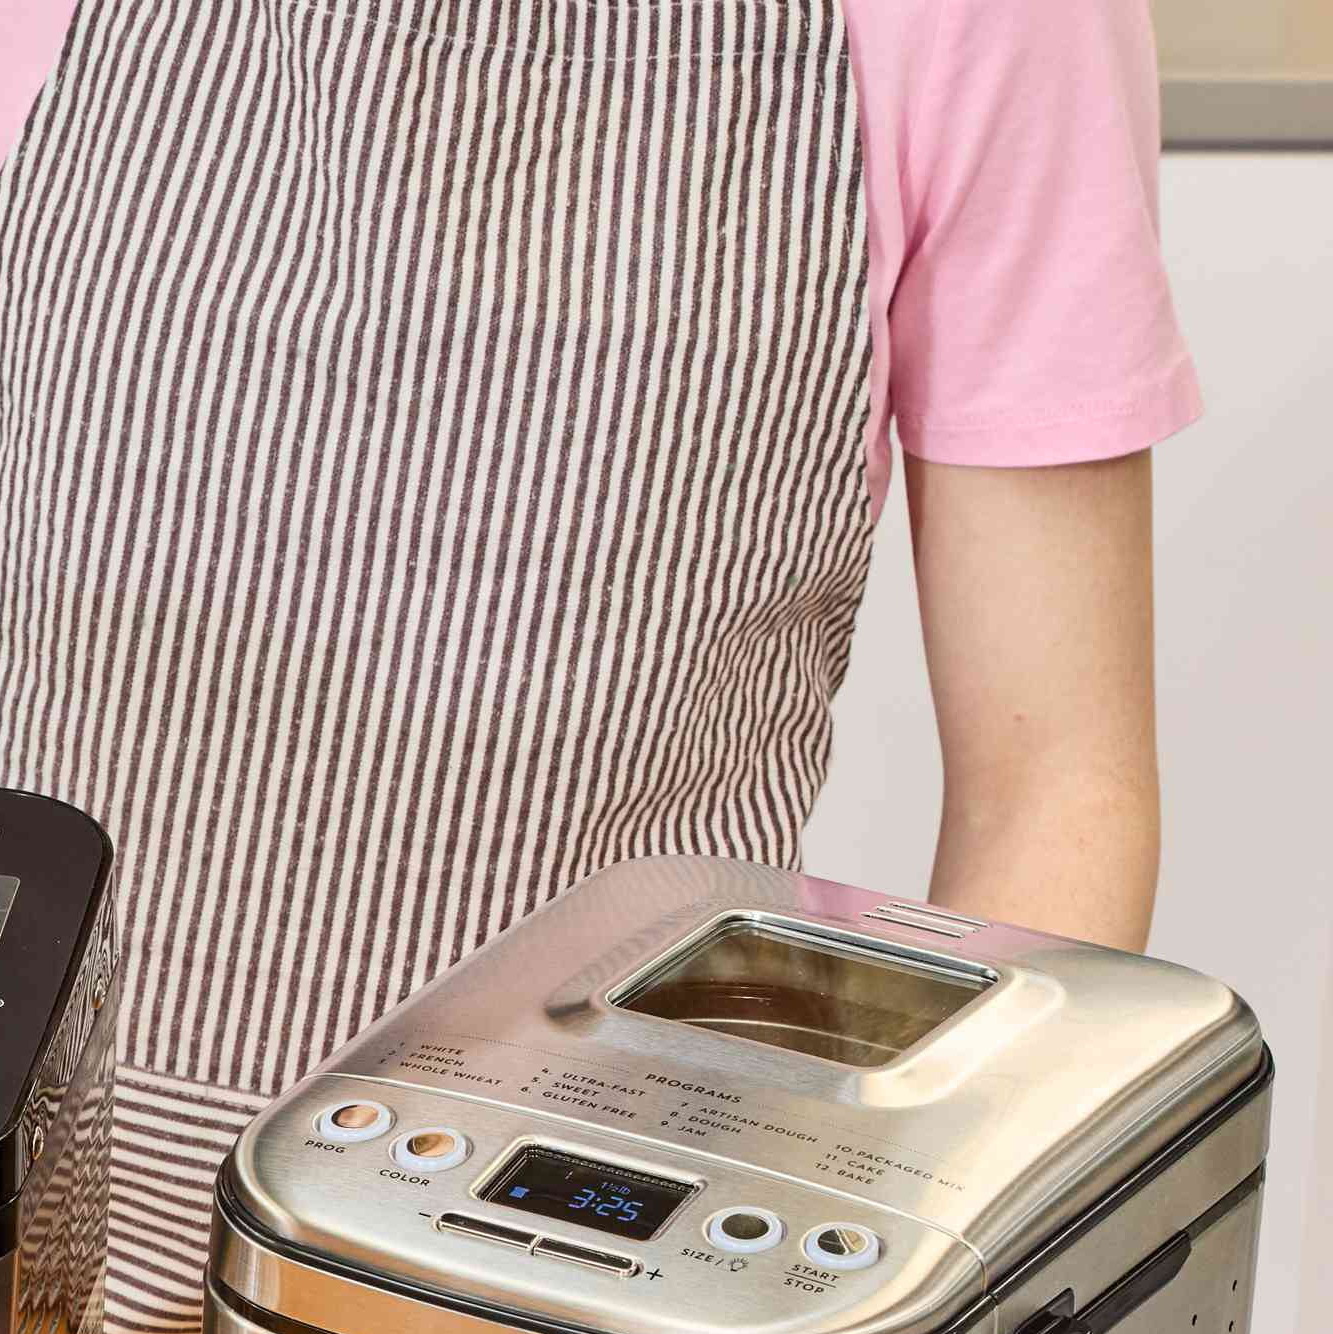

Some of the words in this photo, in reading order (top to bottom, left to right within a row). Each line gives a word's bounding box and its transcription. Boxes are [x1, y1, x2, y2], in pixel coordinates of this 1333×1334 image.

[421, 1044, 465, 1055] WHITE
[410, 1052, 465, 1067] FRENCH
[400, 1061, 449, 1075] WHOLE
[454, 1071, 502, 1086] WHEAT
[552, 1082, 600, 1097] SWEET
[562, 1072, 646, 1097] ULTRA-FAST
[645, 1073, 741, 1103] PROGRAMS
[542, 1091, 598, 1109] GLUTEN
[602, 1105, 637, 1119] FREE
[677, 1126, 707, 1137] JAM
[688, 1116, 742, 1134] DOUGH
[699, 1107, 760, 1127] ARTISAN
[764, 1124, 819, 1143] DOUGH
[305, 1139, 347, 1154] PROG
[837, 1169, 876, 1185] BAKE
[847, 1160, 885, 1176] CAKE
[856, 1151, 933, 1180] PACKAGED
[938, 1178, 966, 1192] MIX
[379, 1169, 430, 1187] COLOR
[567, 1188, 644, 1221] 3:25
[791, 1264, 841, 1282] START
[783, 1278, 825, 1294] STOP
